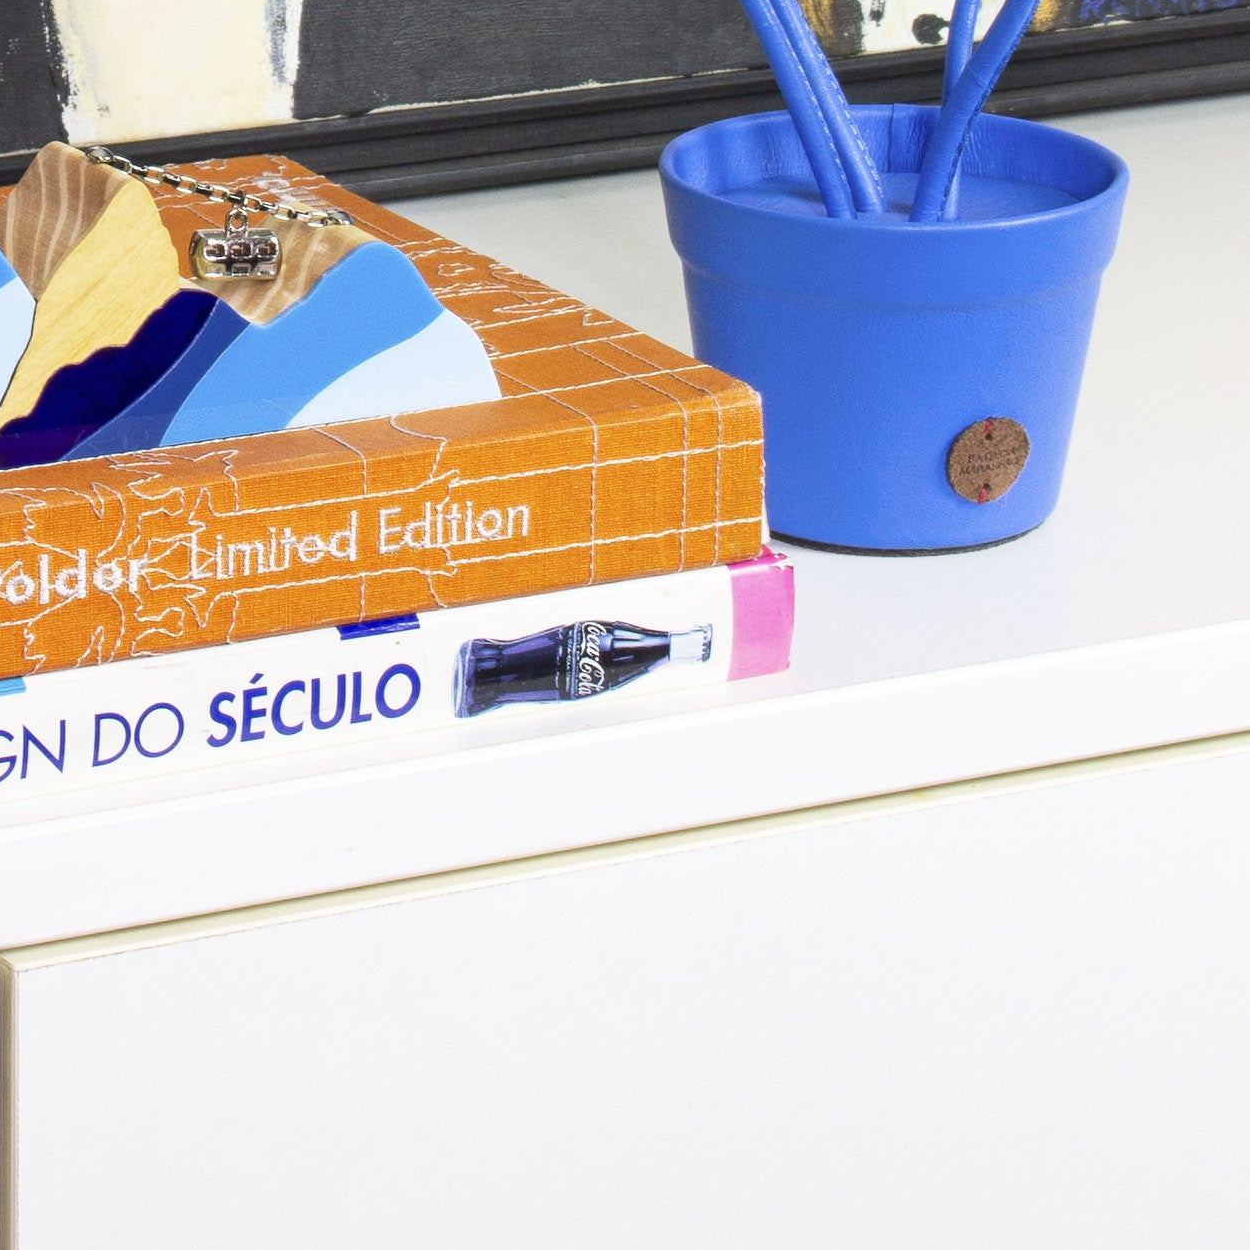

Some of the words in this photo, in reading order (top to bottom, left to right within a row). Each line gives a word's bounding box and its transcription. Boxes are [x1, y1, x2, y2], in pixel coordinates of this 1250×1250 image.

[189, 510, 359, 581] Limited
[378, 500, 530, 555] Edition
[92, 702, 185, 767] DO
[206, 663, 421, 747] SÉCULO
